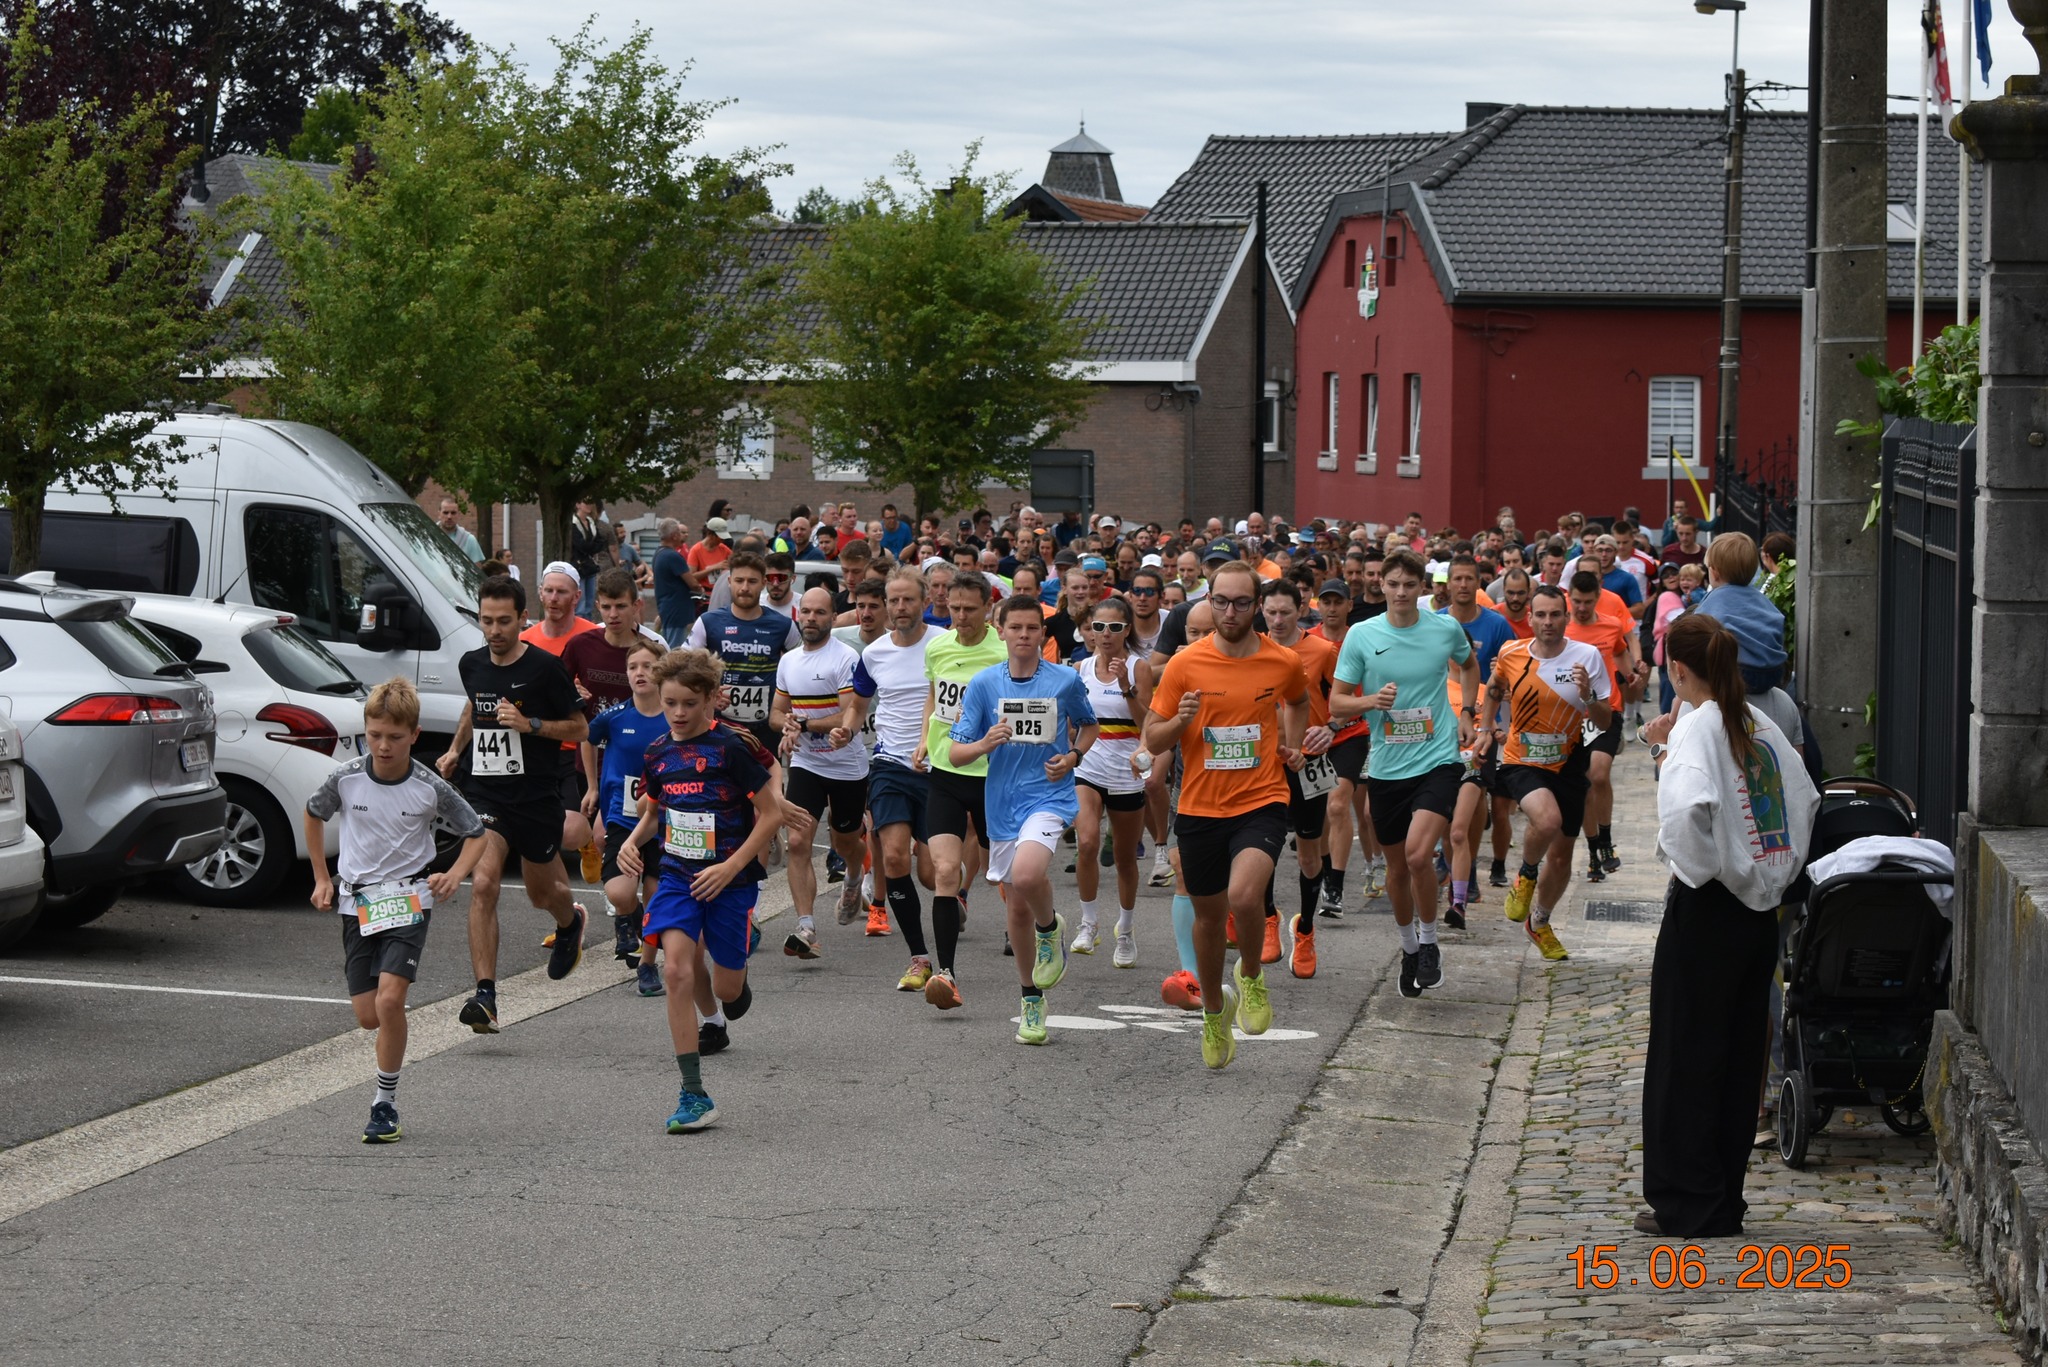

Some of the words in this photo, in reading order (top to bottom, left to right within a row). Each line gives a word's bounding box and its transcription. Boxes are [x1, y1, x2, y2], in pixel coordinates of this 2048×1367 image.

[721, 639, 771, 656] Respire
[731, 687, 763, 707] 644
[1016, 720, 1041, 736] 825
[1393, 722, 1424, 735] 2959
[477, 732, 512, 757] 441
[1214, 743, 1250, 758] 2961
[1529, 746, 1558, 757] 2944
[352, 804, 368, 812] JAKO
[671, 829, 704, 848] 2966
[369, 898, 408, 921] 2965
